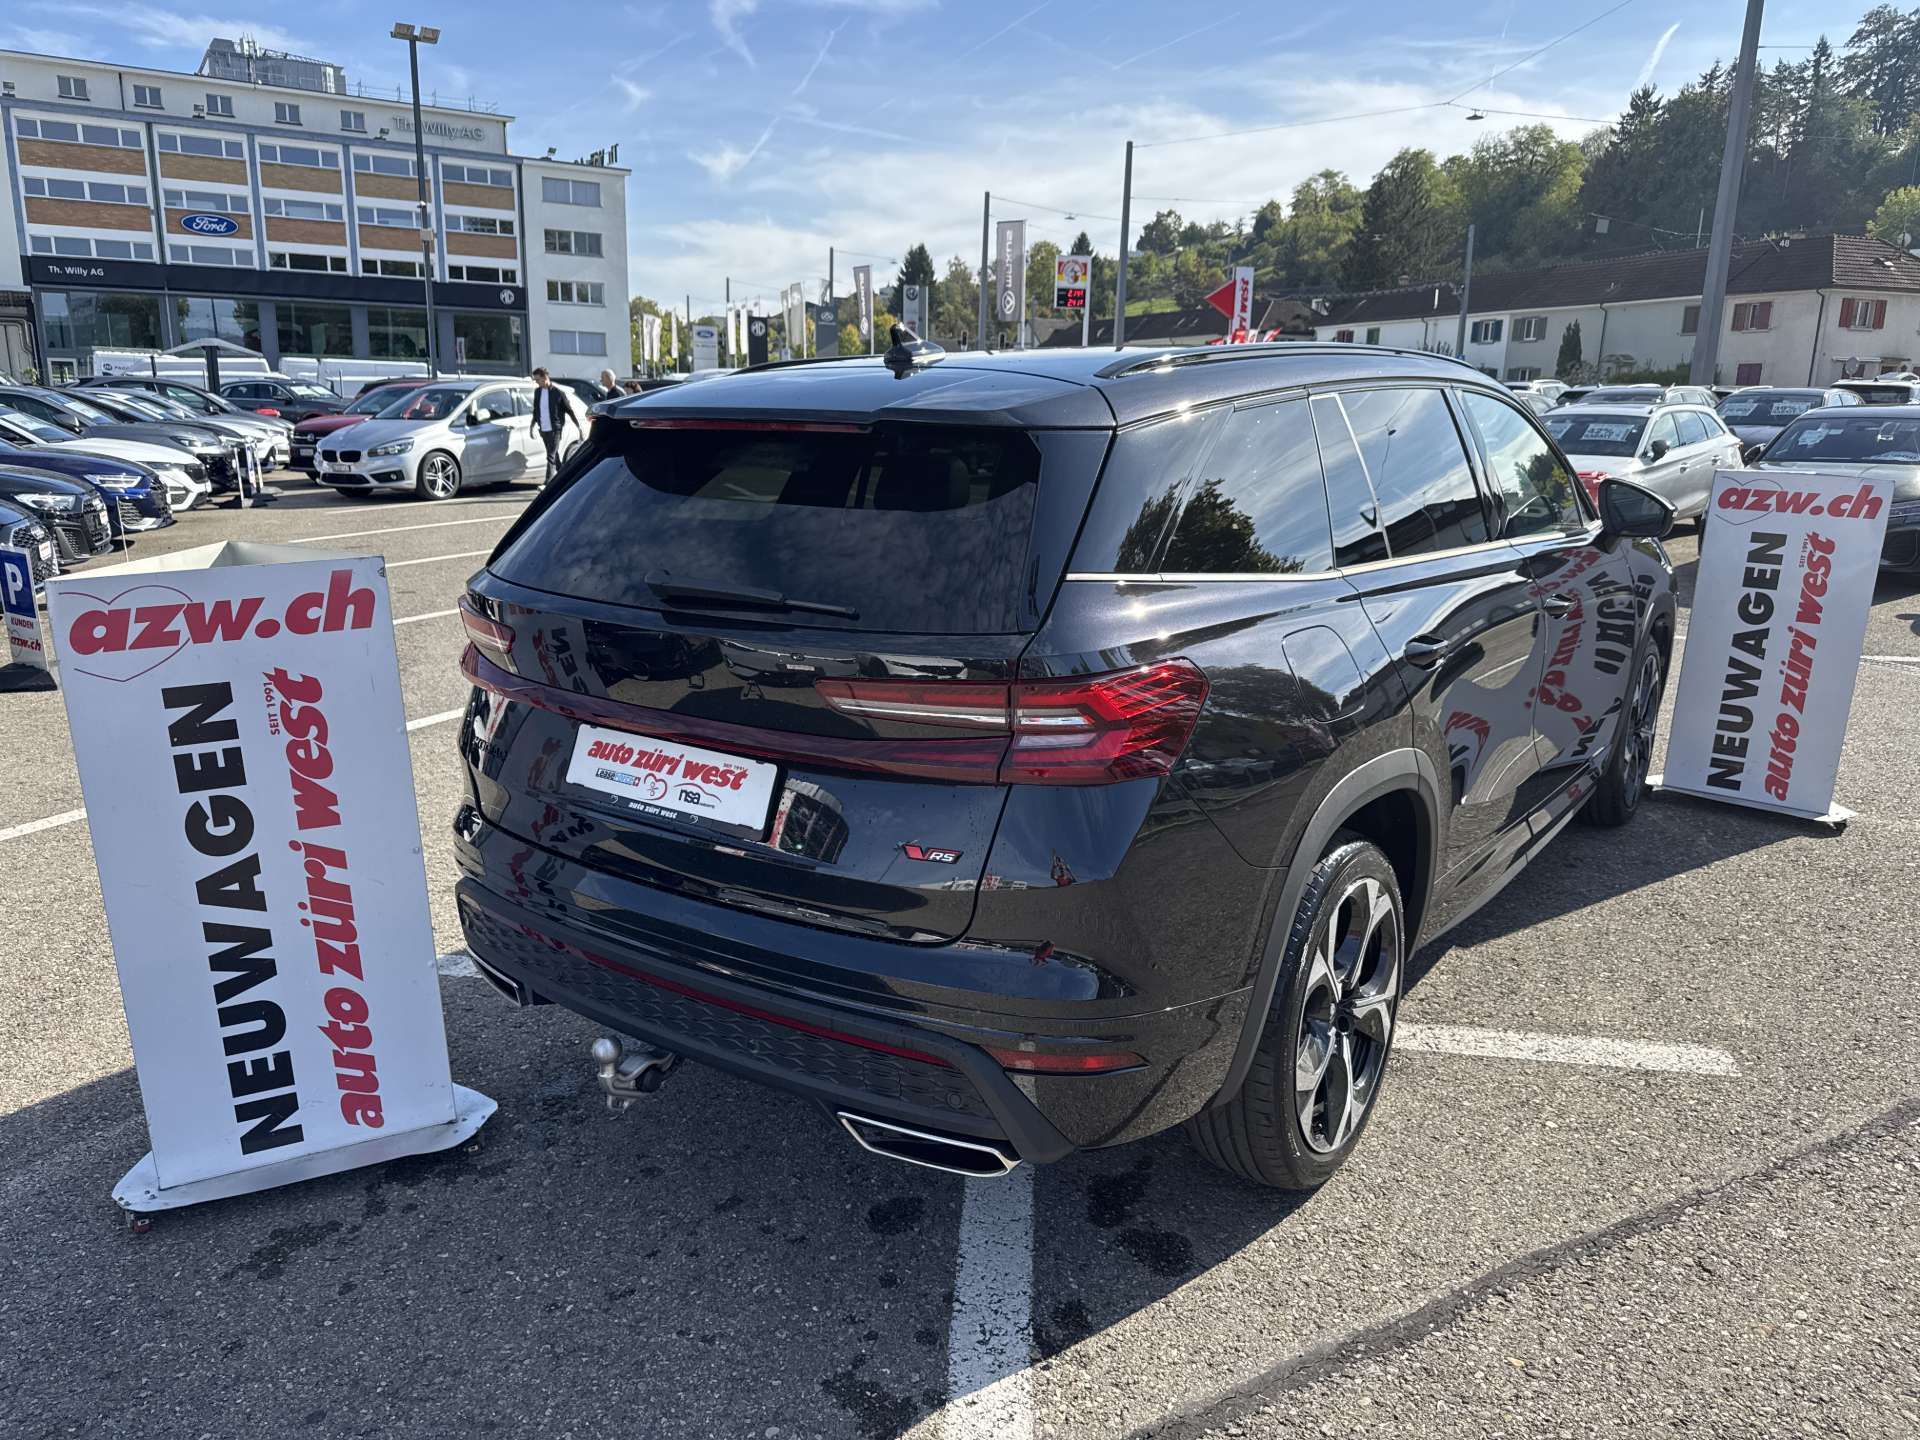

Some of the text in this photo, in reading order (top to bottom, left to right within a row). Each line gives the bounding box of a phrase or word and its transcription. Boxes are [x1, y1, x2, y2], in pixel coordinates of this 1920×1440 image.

[421, 120, 457, 140] Willy
[461, 127, 485, 140] AG
[192, 216, 228, 233] Ford
[48, 265, 104, 277] Th. Willy AG
[1717, 484, 1884, 520] azw.ch
[4, 562, 23, 605] P
[10, 616, 34, 630] KUNDEN
[69, 569, 376, 655] azw.ch
[1706, 531, 1788, 791] NEUWAGEN
[1765, 531, 1836, 801] auto züri west
[263, 682, 280, 735] SEIT 1991
[587, 740, 749, 790] auto züri west
[628, 801, 678, 819] auto züri west
[679, 788, 701, 805] nsa
[161, 681, 304, 1155] NEUWAGEN
[262, 666, 384, 1128] auto züri west
